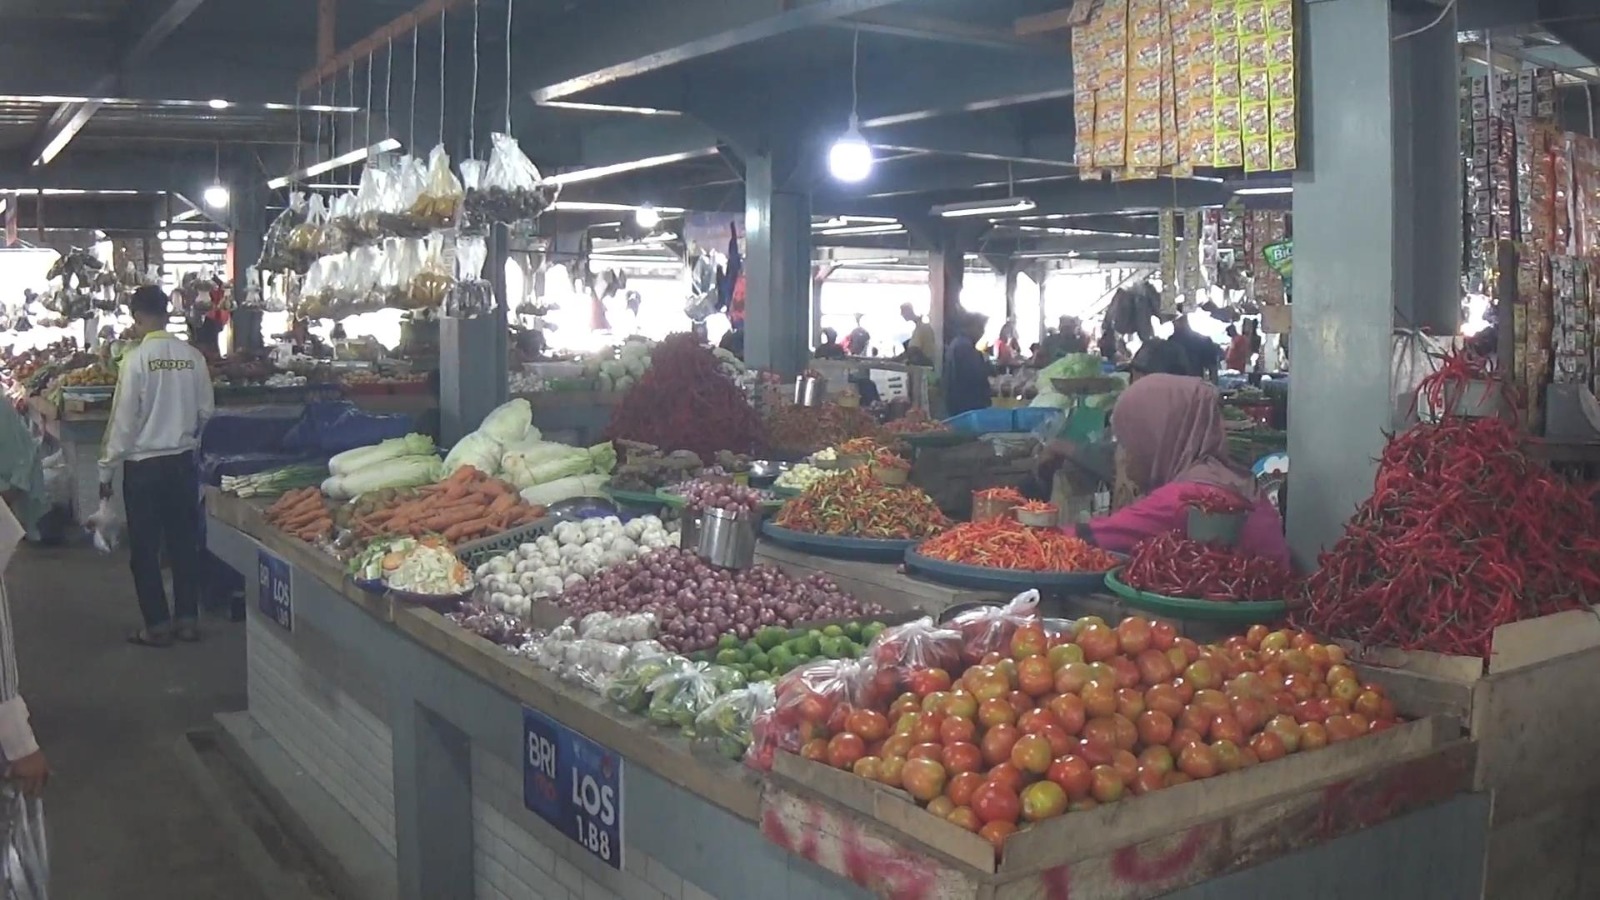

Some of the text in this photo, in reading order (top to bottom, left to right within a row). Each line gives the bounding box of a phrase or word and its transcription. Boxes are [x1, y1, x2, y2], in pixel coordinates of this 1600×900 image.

[149, 359, 194, 371] Kappa
[274, 577, 289, 607] LOS
[529, 731, 556, 779] BRI
[572, 767, 615, 826] LOS
[577, 815, 611, 860] 1.B8
